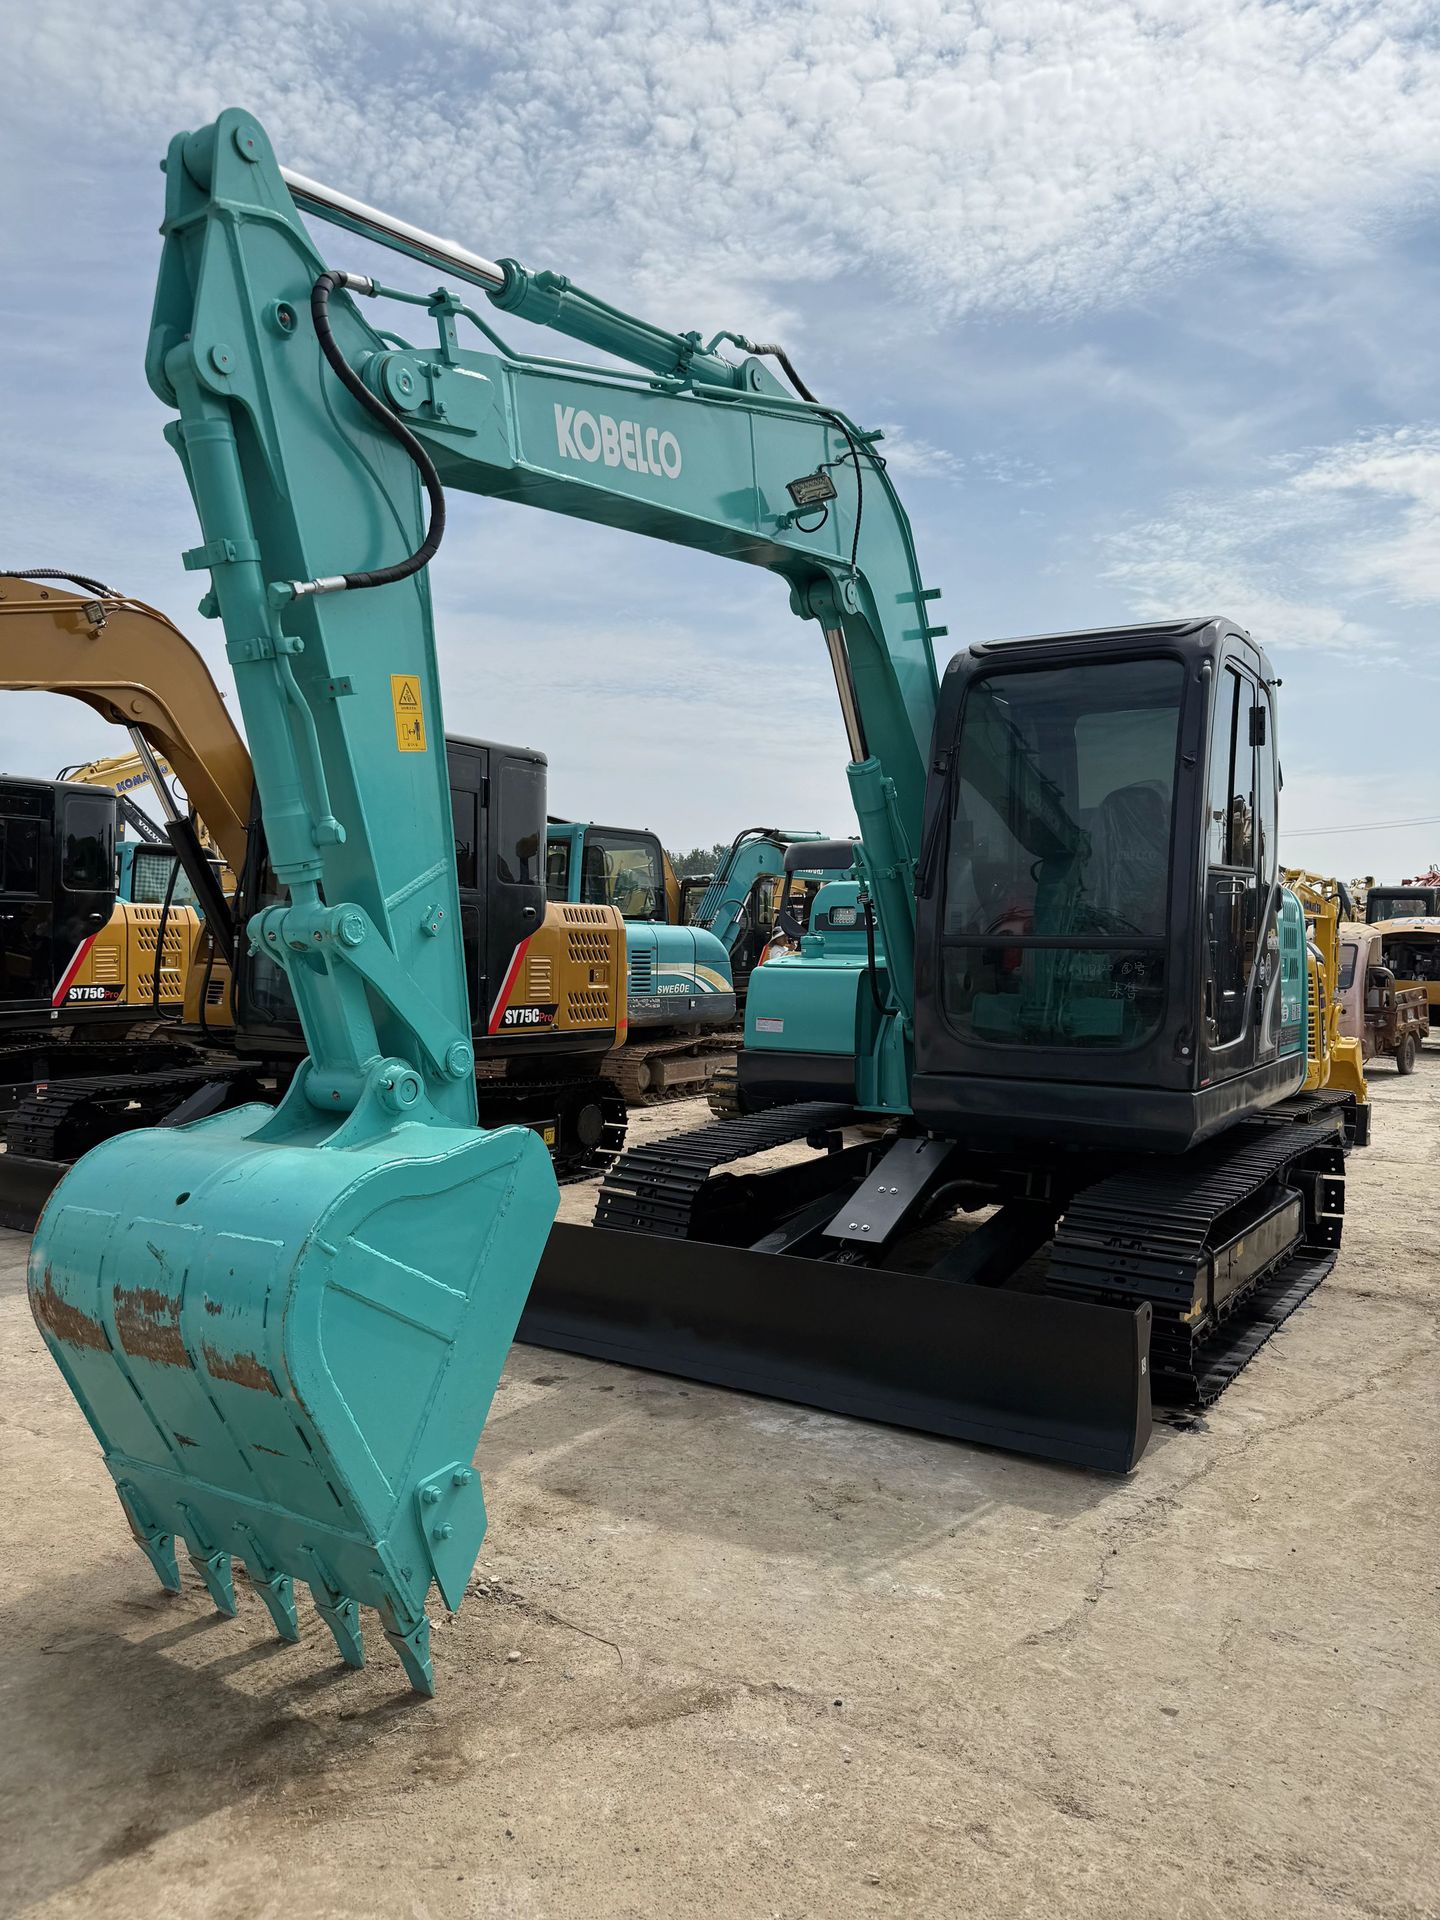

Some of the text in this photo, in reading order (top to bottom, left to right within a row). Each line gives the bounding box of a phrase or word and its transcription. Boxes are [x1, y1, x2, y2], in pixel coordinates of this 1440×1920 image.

[553, 403, 683, 480] KOBELCO
[139, 818, 162, 844] VOLVO
[657, 983, 690, 994] SWE60E
